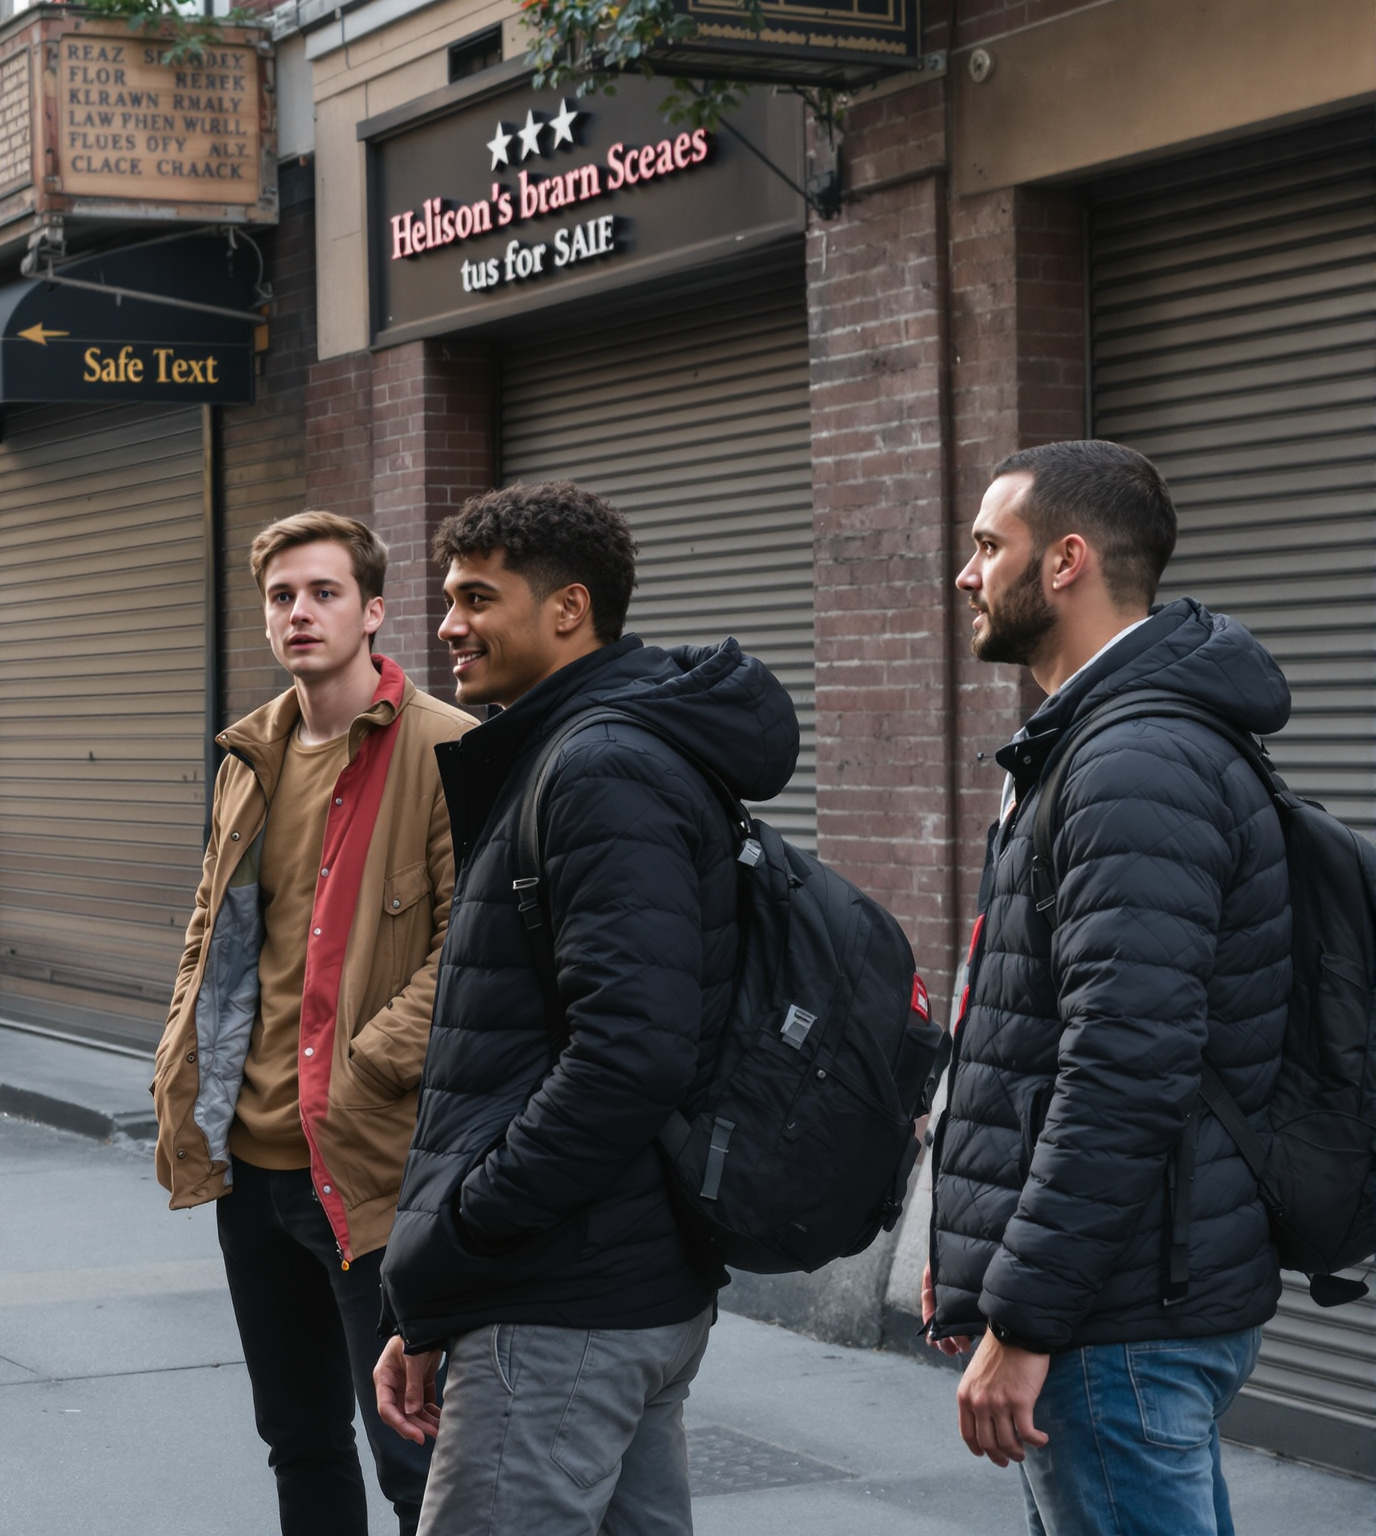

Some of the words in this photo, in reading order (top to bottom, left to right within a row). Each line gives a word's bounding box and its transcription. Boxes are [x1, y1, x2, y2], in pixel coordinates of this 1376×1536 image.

[68, 66, 127, 86] FLOR
[69, 110, 115, 128] LAW
[121, 112, 175, 131] PHEN
[68, 131, 137, 150] FLUES
[71, 155, 142, 176] CLACE
[390, 182, 513, 260] Helison's
[518, 170, 602, 219] brarn
[607, 127, 709, 190] Sceaes
[460, 257, 499, 292] tus
[504, 239, 546, 281] for
[84, 345, 143, 382] Safe
[153, 348, 219, 384] Text
